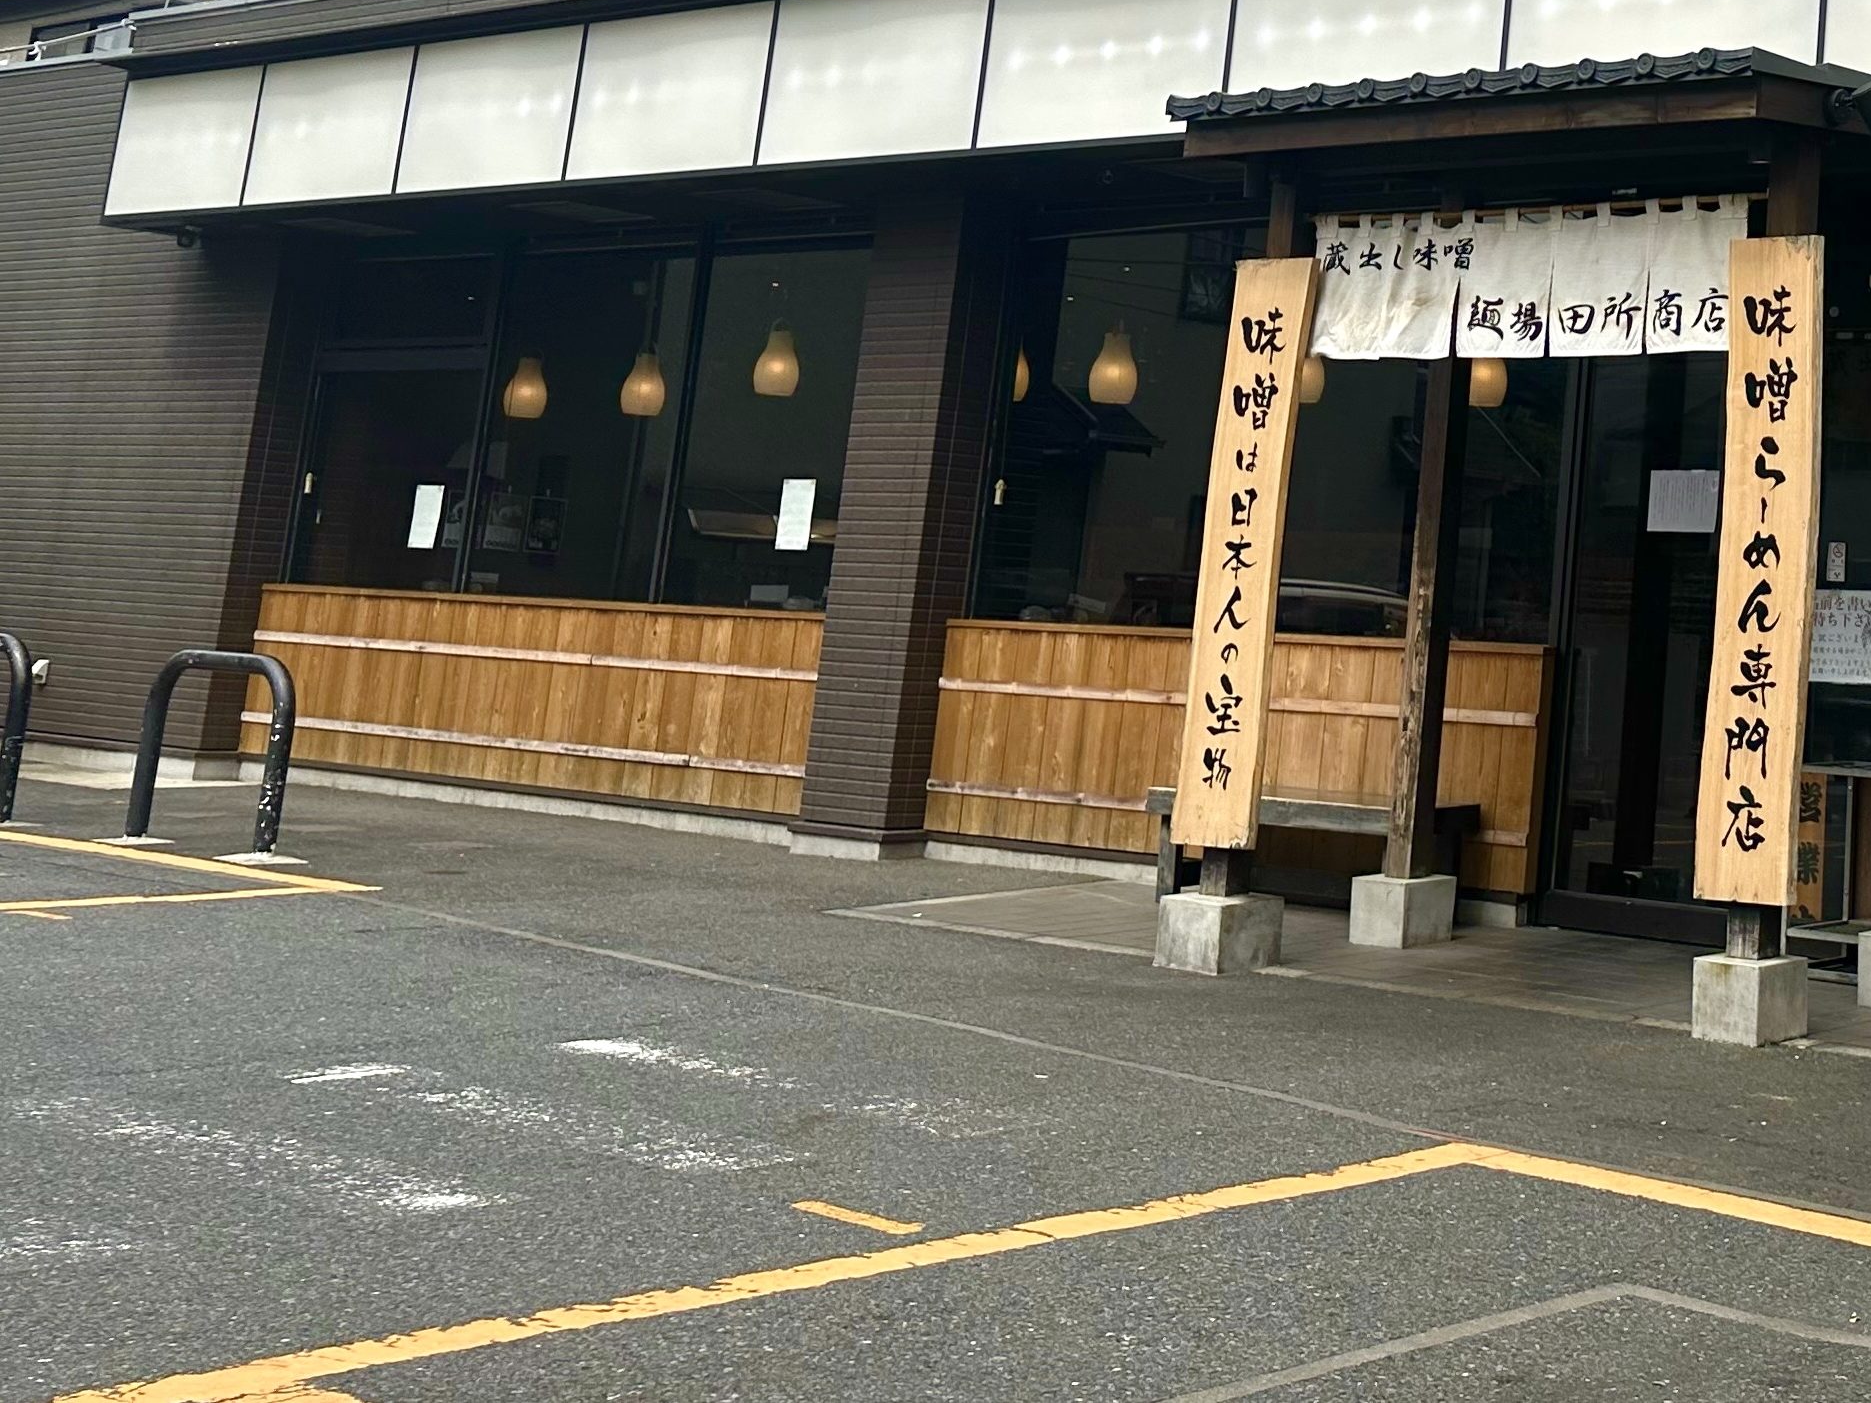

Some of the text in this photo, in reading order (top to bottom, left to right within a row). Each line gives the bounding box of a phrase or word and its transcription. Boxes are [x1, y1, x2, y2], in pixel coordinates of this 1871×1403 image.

[1323, 237, 1475, 275] 蔵出し味噌
[1202, 306, 1287, 791] 味噌は日本人の宝物
